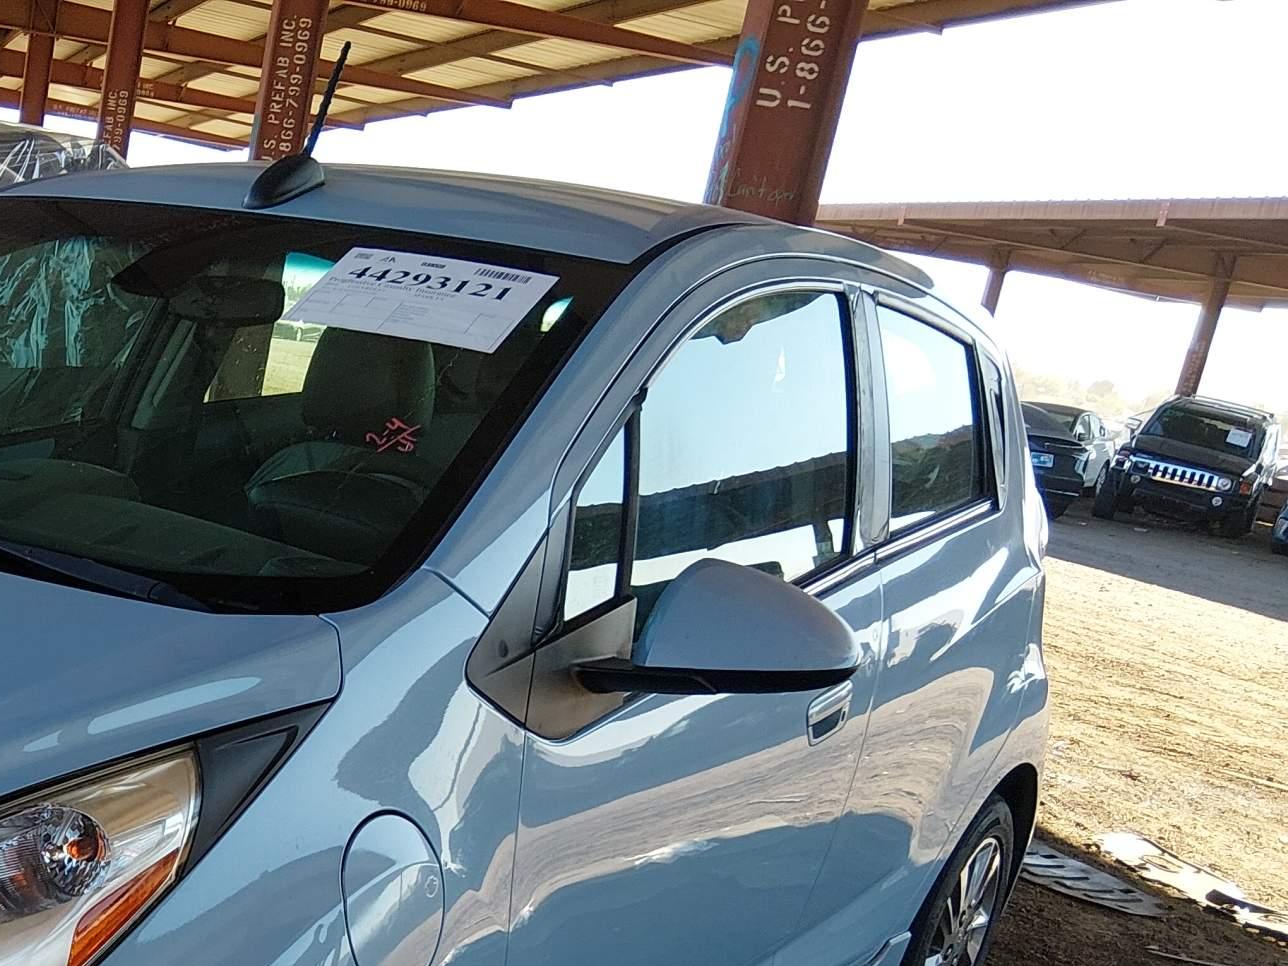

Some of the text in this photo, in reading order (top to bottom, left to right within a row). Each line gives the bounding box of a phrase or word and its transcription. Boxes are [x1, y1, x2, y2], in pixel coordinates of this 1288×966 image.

[267, 57, 290, 125] PREFAB
[279, 14, 298, 47] INC.
[279, 17, 313, 158] -866-799-0969
[348, 266, 512, 301] 44293121
